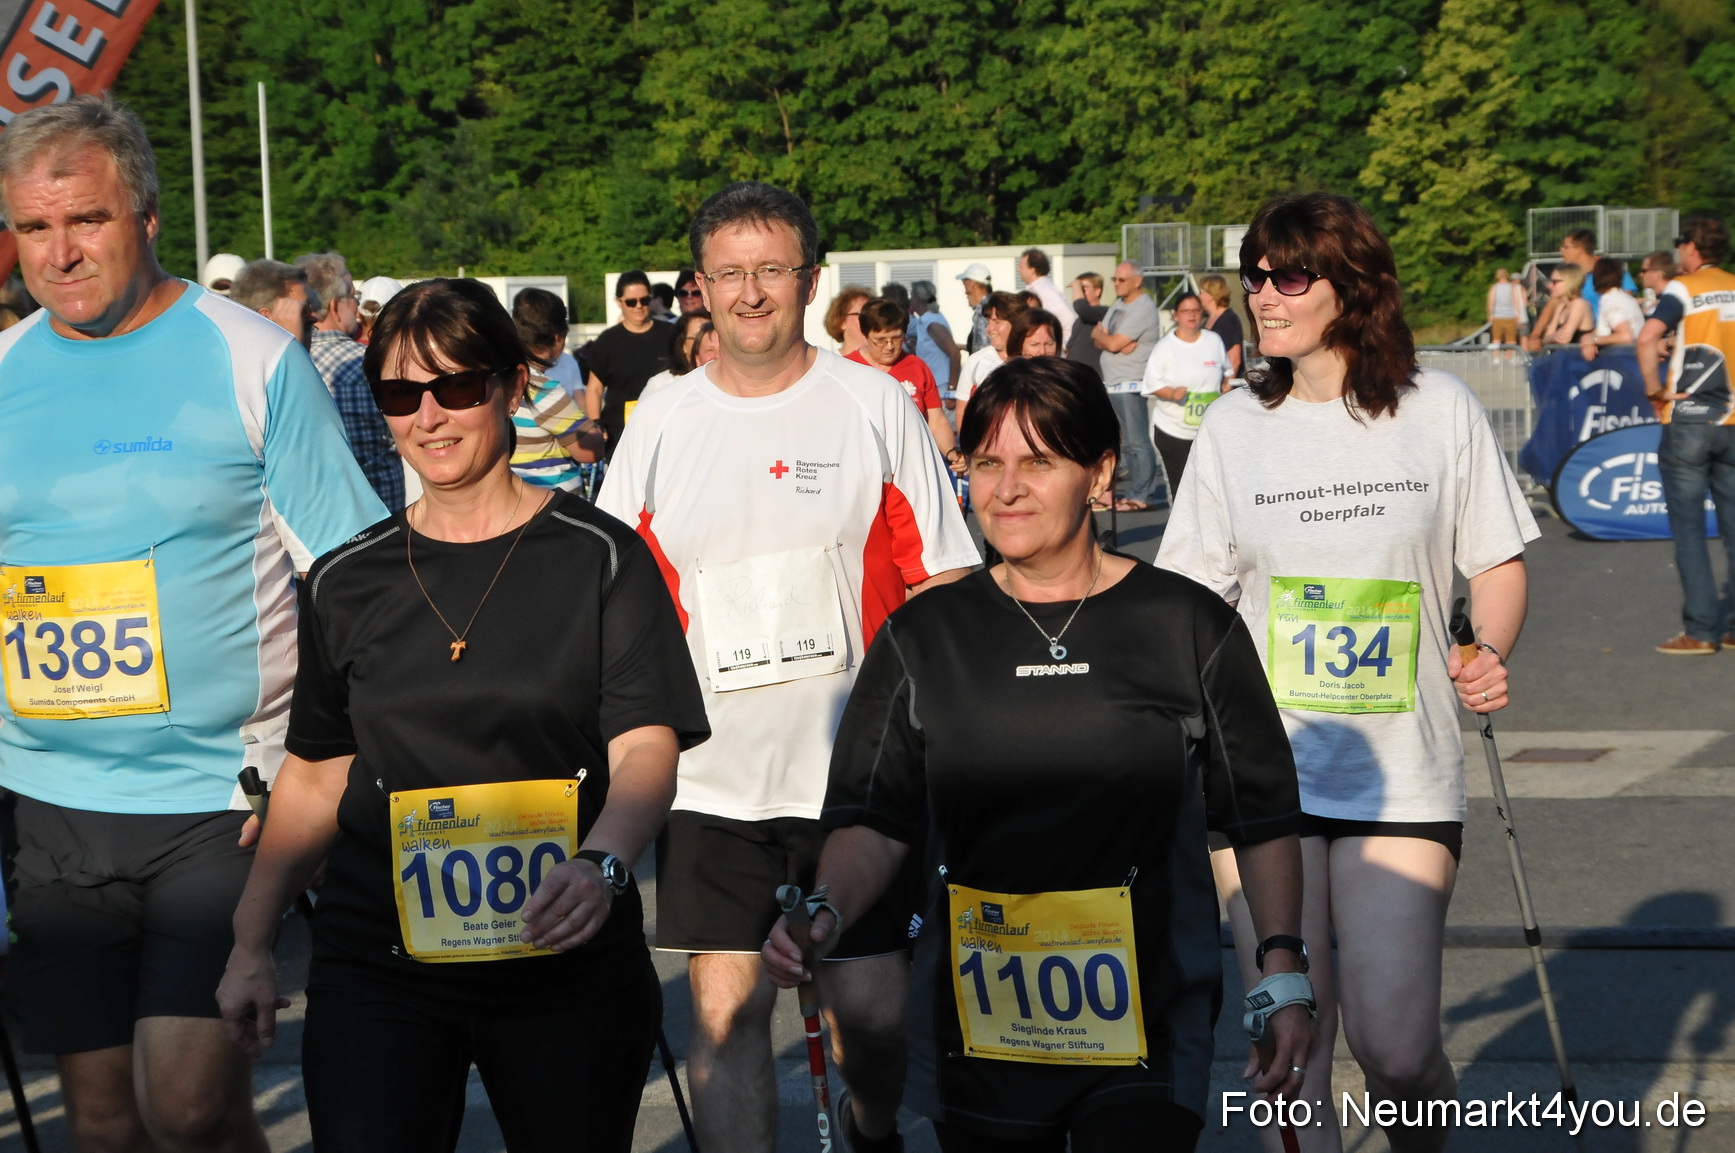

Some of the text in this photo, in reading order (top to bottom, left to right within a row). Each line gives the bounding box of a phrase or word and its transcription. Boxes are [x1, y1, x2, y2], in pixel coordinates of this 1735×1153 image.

[1187, 403, 1209, 417] 10
[112, 436, 173, 454] sumida
[796, 460, 840, 468] Bayerisches
[796, 486, 821, 495] Richard
[1255, 479, 1430, 506] Burnout-Helpcenter
[1299, 503, 1386, 523] Oberpfalz
[16, 592, 65, 604] firmenlauf
[1294, 598, 1346, 610] firmenlauf
[6, 609, 43, 621] walken
[5, 617, 153, 681] 1385
[797, 639, 816, 651] 119
[1292, 624, 1392, 678] 134
[733, 648, 751, 661] 119
[1016, 663, 1089, 676] STANNO
[53, 683, 103, 694] Josef Weigl
[1319, 680, 1365, 689] Doris Jacob
[29, 694, 136, 707] Sumida Components GmbH
[1289, 690, 1358, 700] Burnout-Helpcenter
[417, 814, 480, 832] firmenlauf
[401, 837, 452, 853] walken
[402, 842, 567, 918] 1080
[463, 920, 516, 931] Beate Geier
[974, 918, 1030, 936] firmenlauf
[441, 938, 471, 947] Regens
[473, 935, 505, 947] Wagner
[960, 936, 1002, 954] walken
[960, 951, 1129, 1021] 1100
[1011, 1023, 1087, 1036] Sieglinde Kraus
[1000, 1035, 1104, 1051] Regens Wagner Stiftung
